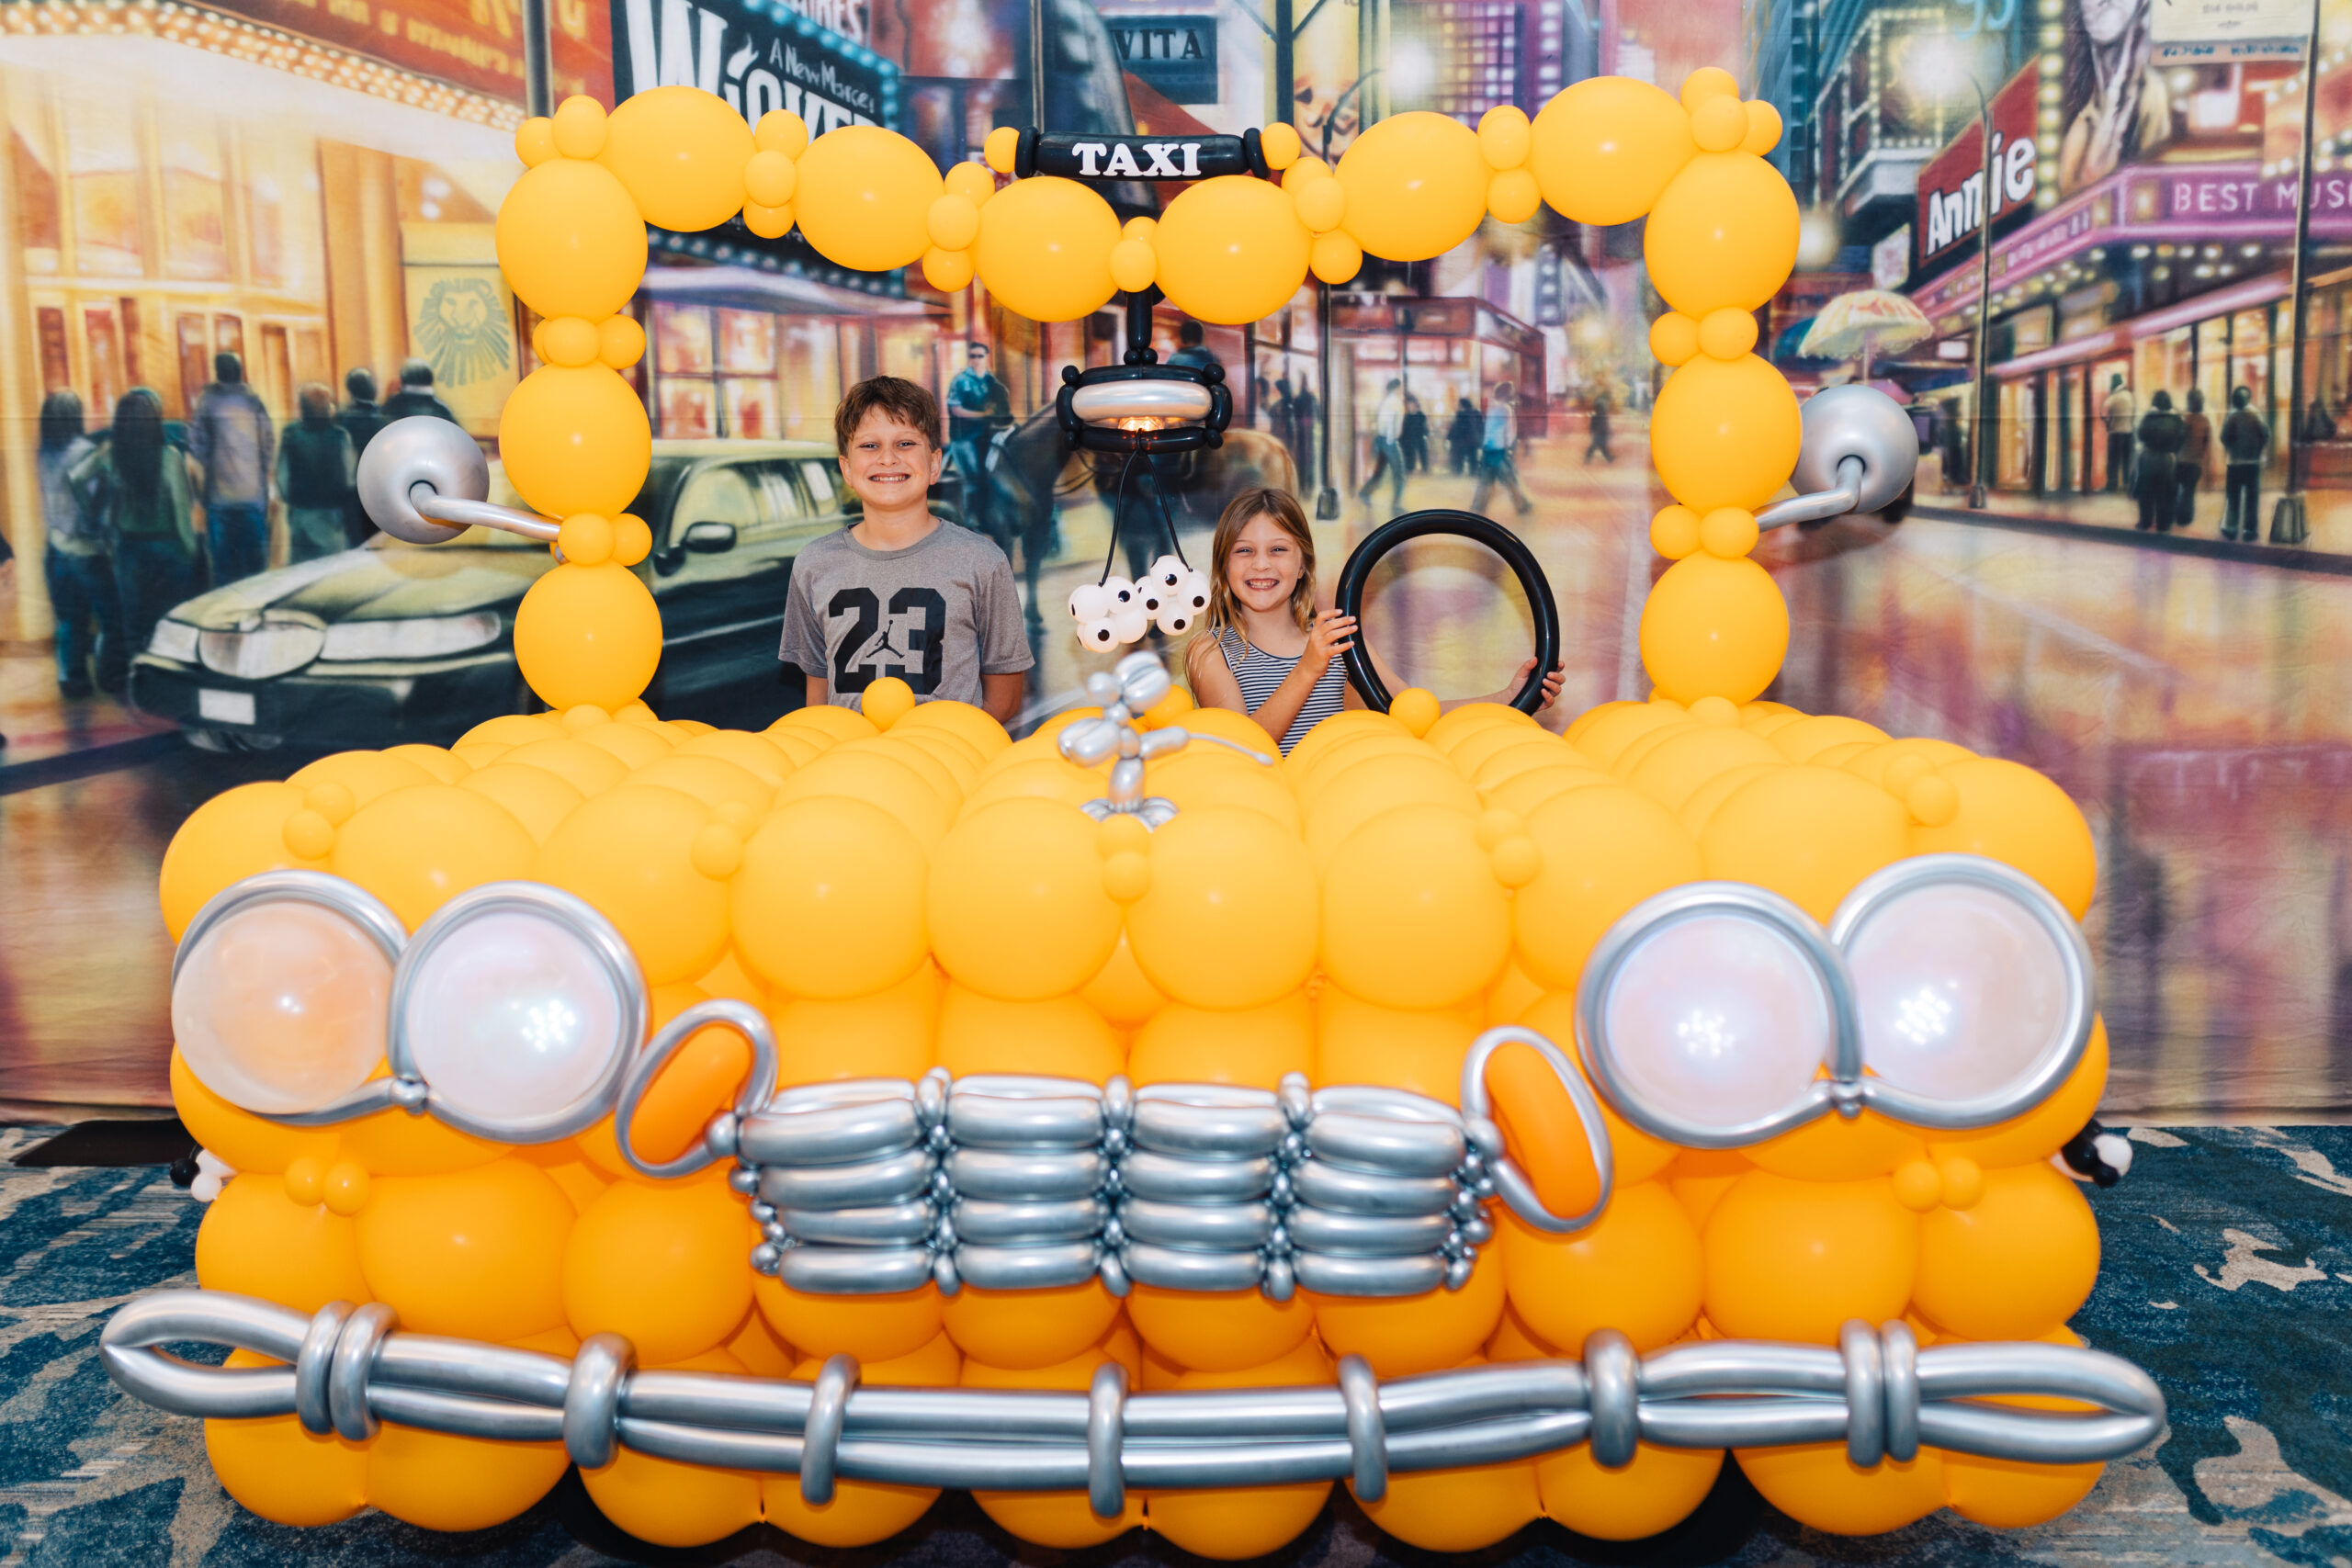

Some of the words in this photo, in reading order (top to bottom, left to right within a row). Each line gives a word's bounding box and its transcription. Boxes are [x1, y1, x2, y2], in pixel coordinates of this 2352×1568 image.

[769, 37, 783, 70] A
[786, 42, 820, 86] New
[1110, 28, 1203, 60] VITA
[1071, 142, 1202, 176] TAXI
[1927, 131, 2036, 257] Annie
[2174, 183, 2258, 212] BEST
[829, 587, 946, 695] 23
